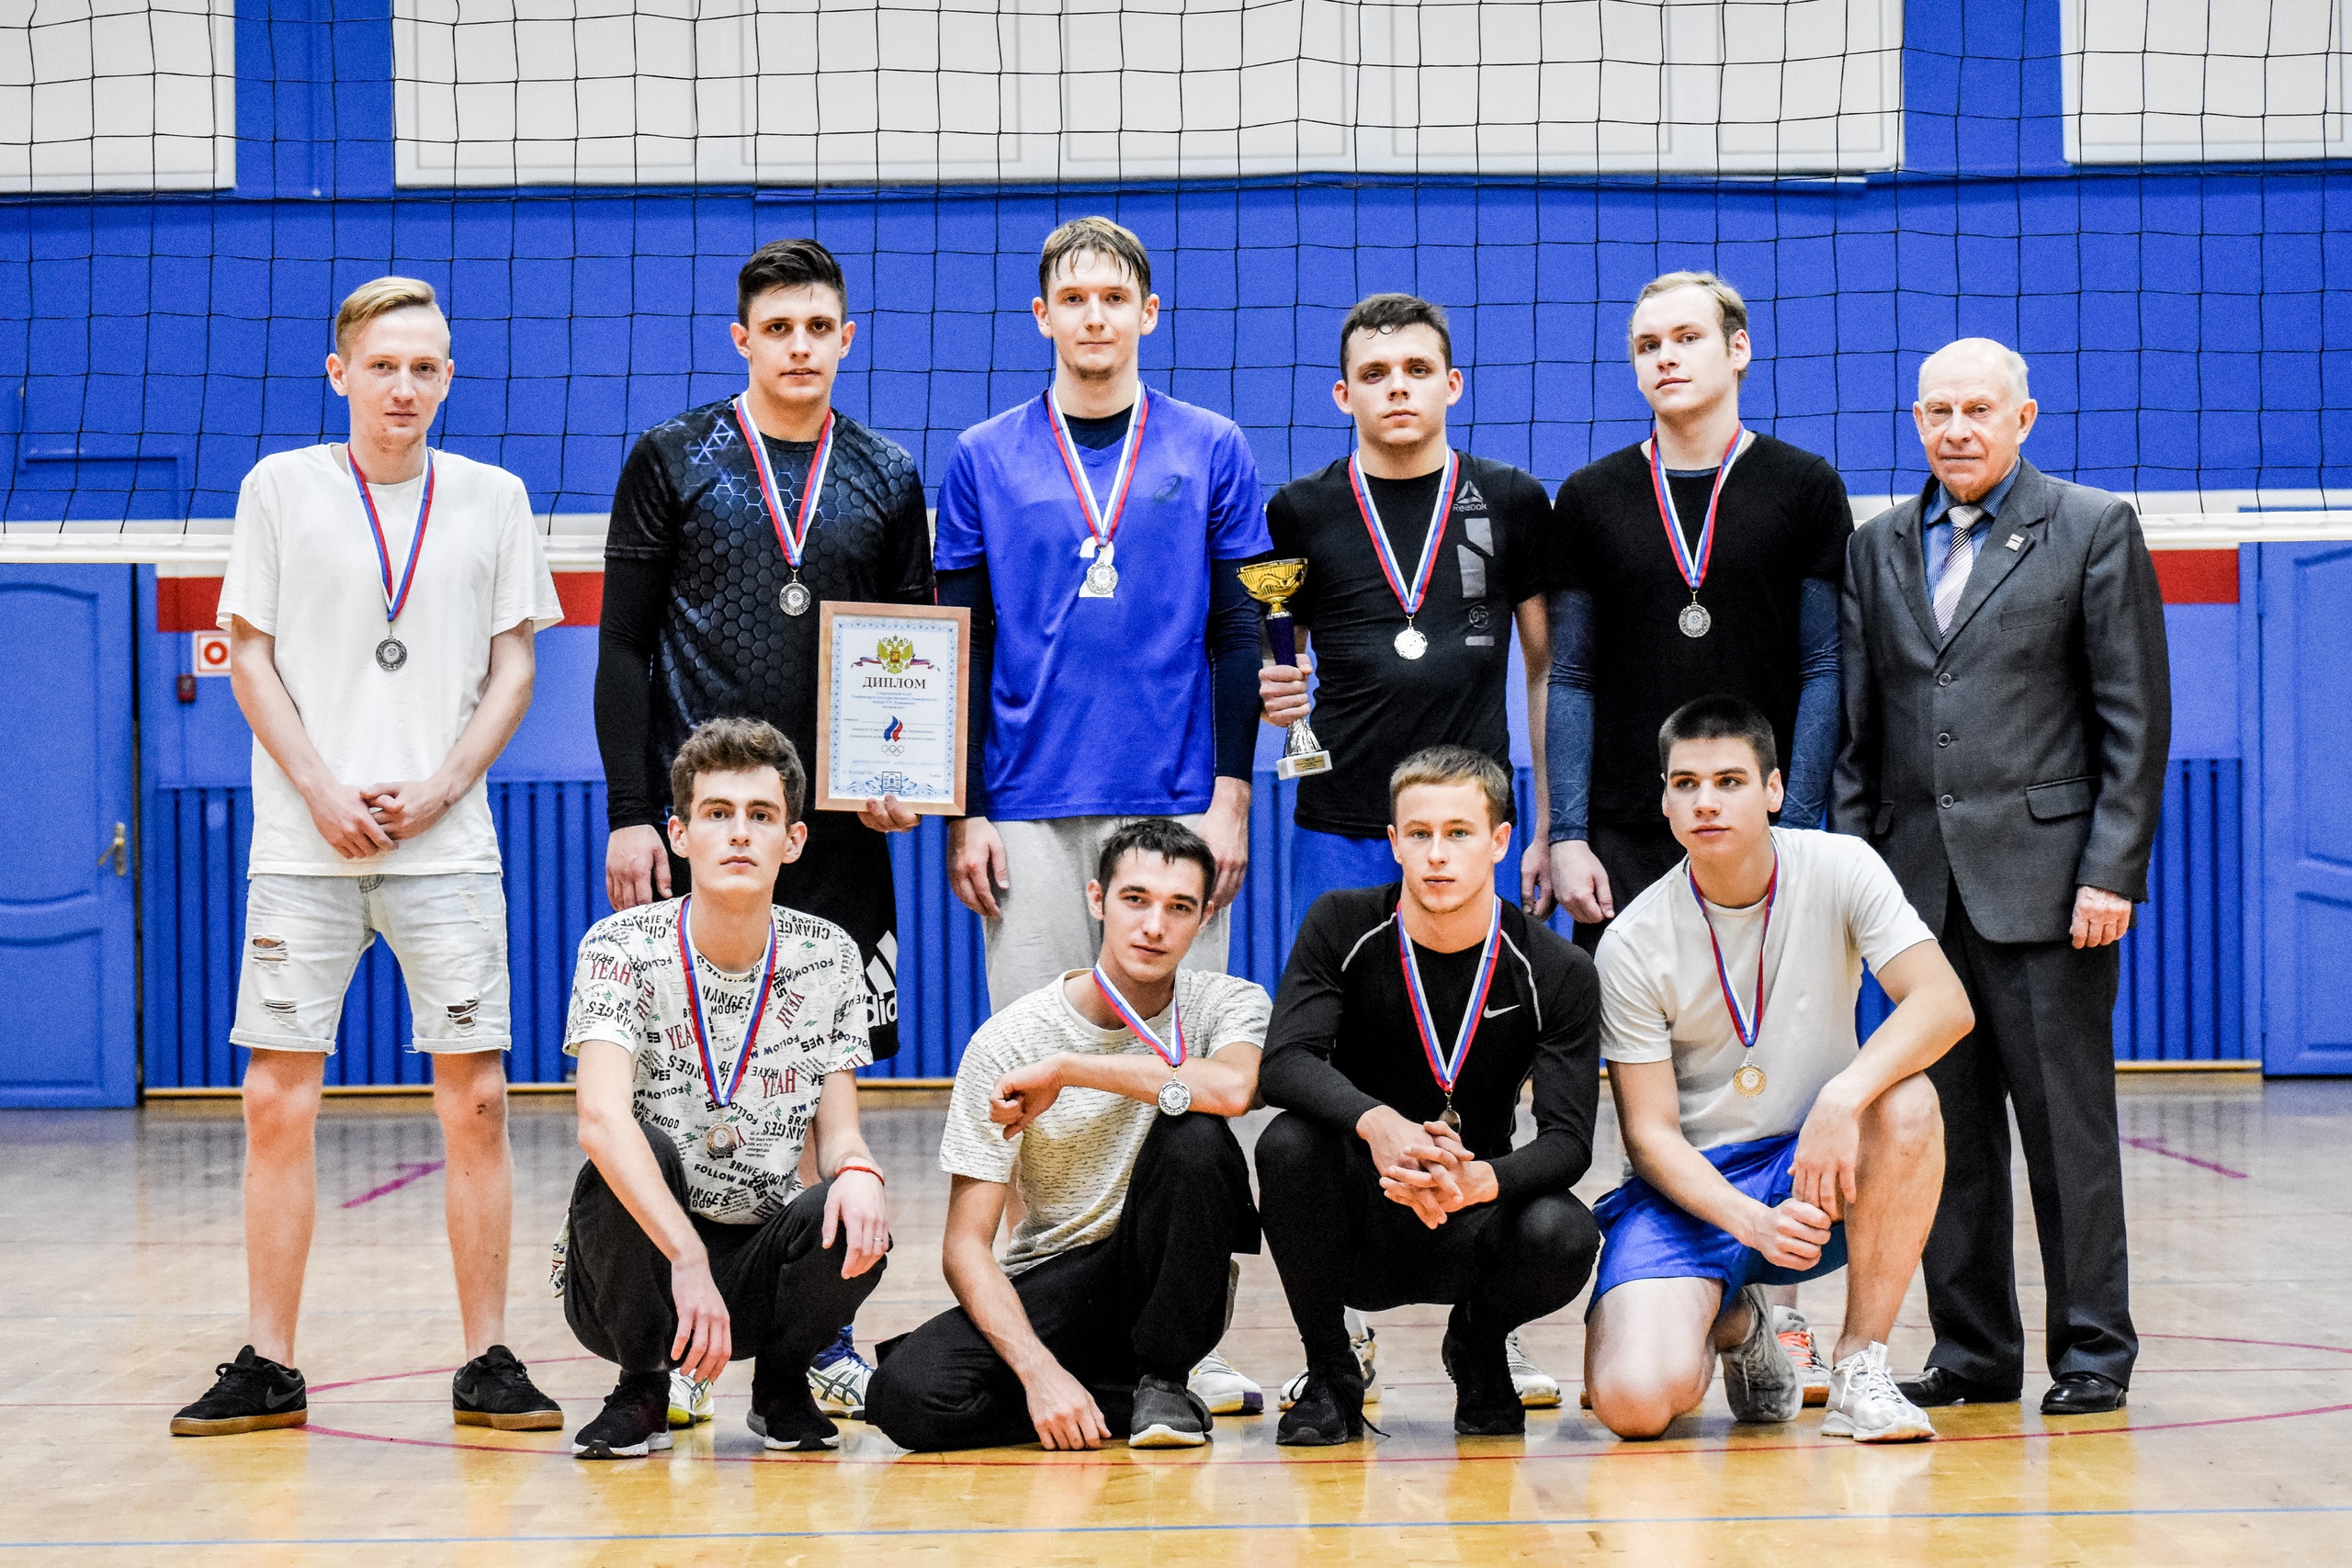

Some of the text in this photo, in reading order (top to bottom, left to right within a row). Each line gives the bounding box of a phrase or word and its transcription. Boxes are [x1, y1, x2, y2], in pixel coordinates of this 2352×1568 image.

[1452, 502, 1487, 512] Reebok
[1079, 536, 1114, 598] 2
[863, 676, 926, 689] ДИПЛОМ
[777, 919, 830, 940] CHANGE
[590, 960, 633, 987] YEAH
[776, 990, 806, 1030] YEAH
[664, 1018, 697, 1051] YEA
[763, 1033, 800, 1055] FOLLOW
[800, 1034, 825, 1053] YES
[762, 1067, 797, 1100] YEAH
[810, 1073, 825, 1087] YE
[647, 1086, 684, 1100] FOLLOW
[730, 1101, 759, 1125] FOLLO
[791, 1103, 807, 1114] ME
[651, 1113, 680, 1129] MOOD
[787, 1114, 807, 1127] BRA
[763, 1121, 807, 1141] ANGES
[694, 1164, 737, 1183] FOLLOW
[729, 1159, 760, 1177] BRAVE
[692, 1199, 712, 1209] OOD
